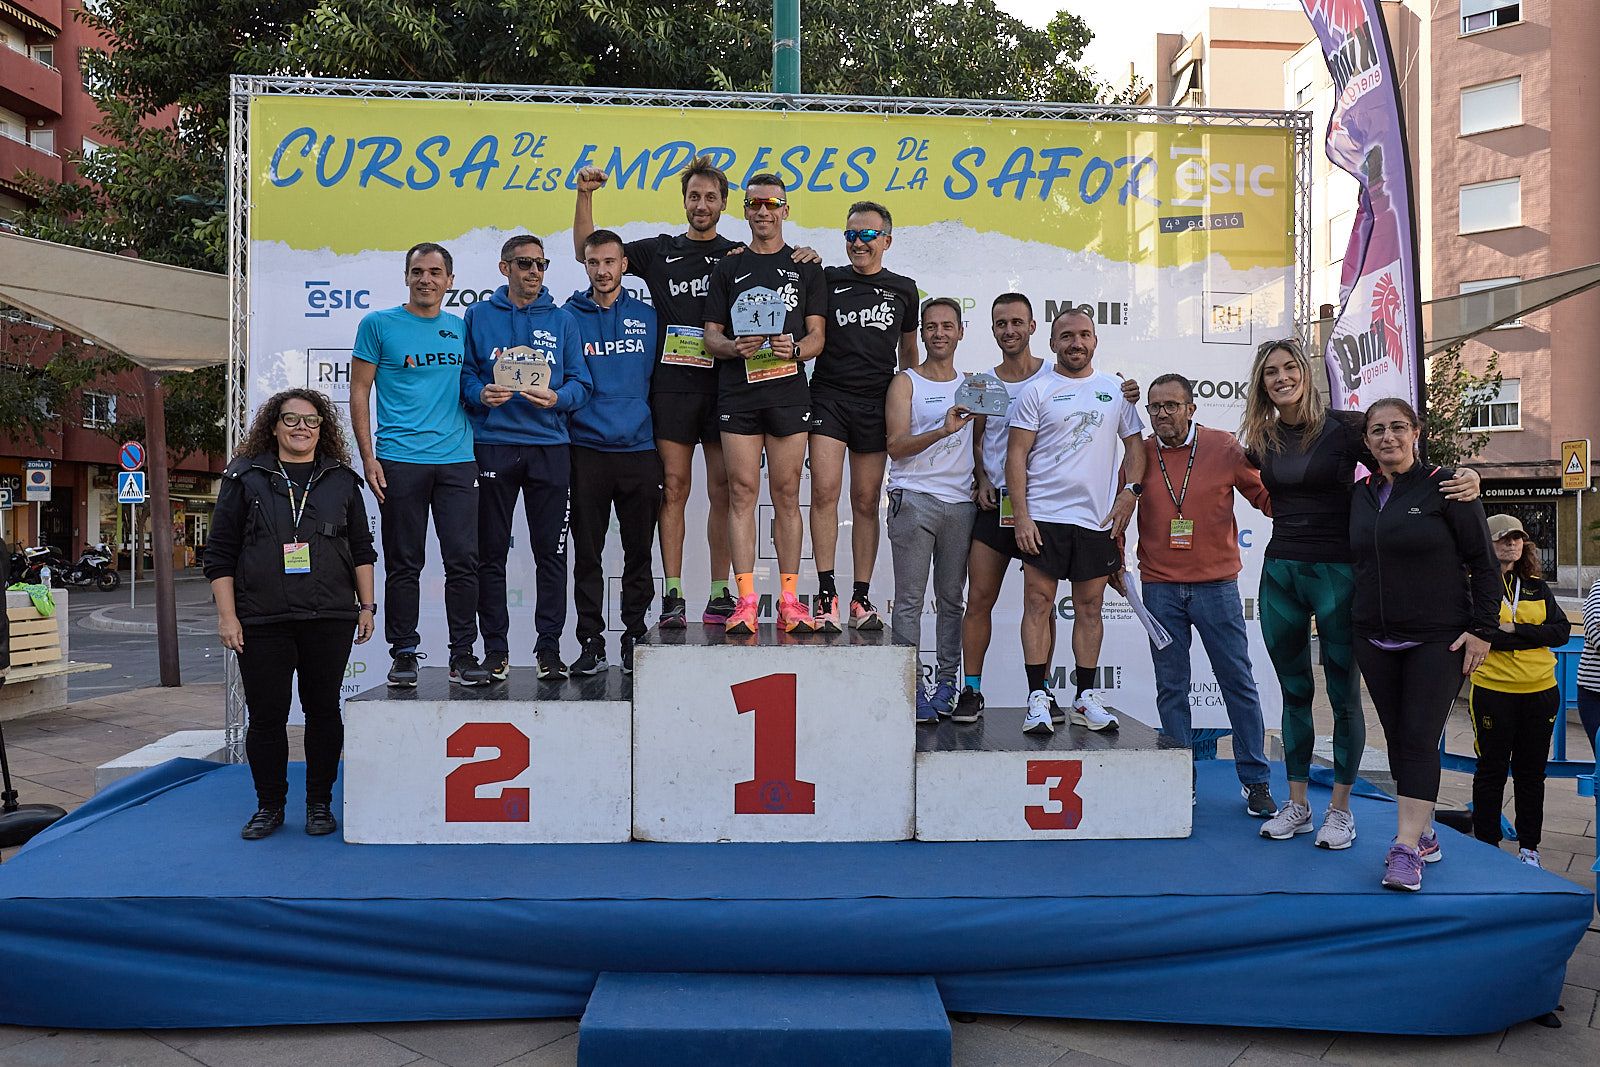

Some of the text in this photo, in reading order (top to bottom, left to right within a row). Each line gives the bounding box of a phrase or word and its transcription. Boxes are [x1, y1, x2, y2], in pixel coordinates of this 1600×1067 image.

[512, 131, 548, 159] DE
[896, 136, 930, 162] DE
[270, 126, 500, 190] CURSA
[565, 140, 876, 193] EMPRESES
[502, 164, 562, 192] LES
[885, 166, 929, 192] LA
[943, 145, 1162, 207] SAFOR
[1187, 214, 1239, 229] edició
[444, 288, 494, 308] ZOO
[835, 308, 857, 327] be
[533, 340, 558, 349] ALPESA
[584, 339, 645, 356] ALPESA
[319, 362, 350, 382] RH
[403, 352, 463, 369] ALPESA
[1188, 380, 1249, 400] ZOOK
[1485, 487, 1564, 497] COMIDAS Y TAPAS
[340, 684, 361, 693] RINT
[730, 672, 816, 815] 1
[445, 722, 530, 822] 2
[1024, 759, 1083, 831] 3
